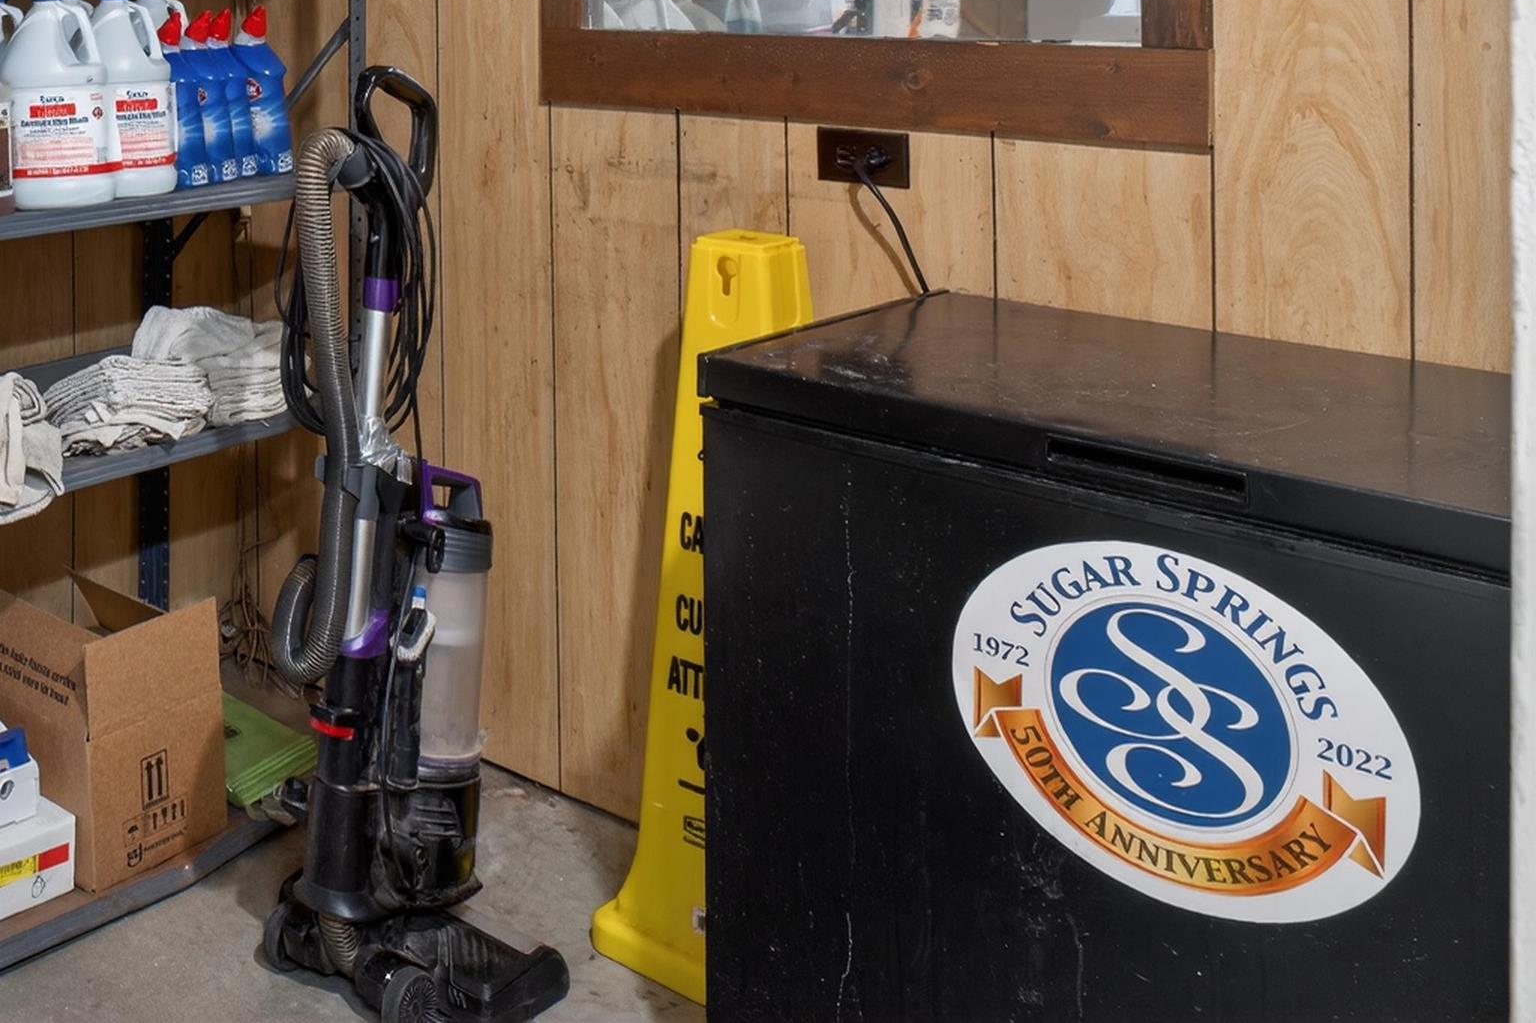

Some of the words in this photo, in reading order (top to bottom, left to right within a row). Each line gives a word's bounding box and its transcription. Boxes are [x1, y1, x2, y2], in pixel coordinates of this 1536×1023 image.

[973, 632, 1030, 667] 1972
[1010, 555, 1141, 637] SUGAR
[1156, 554, 1339, 721] SPRINGS
[1010, 725, 1084, 811] 50TH
[1085, 823, 1332, 885] ANNIVERSARY
[1317, 738, 1392, 780] 2022
